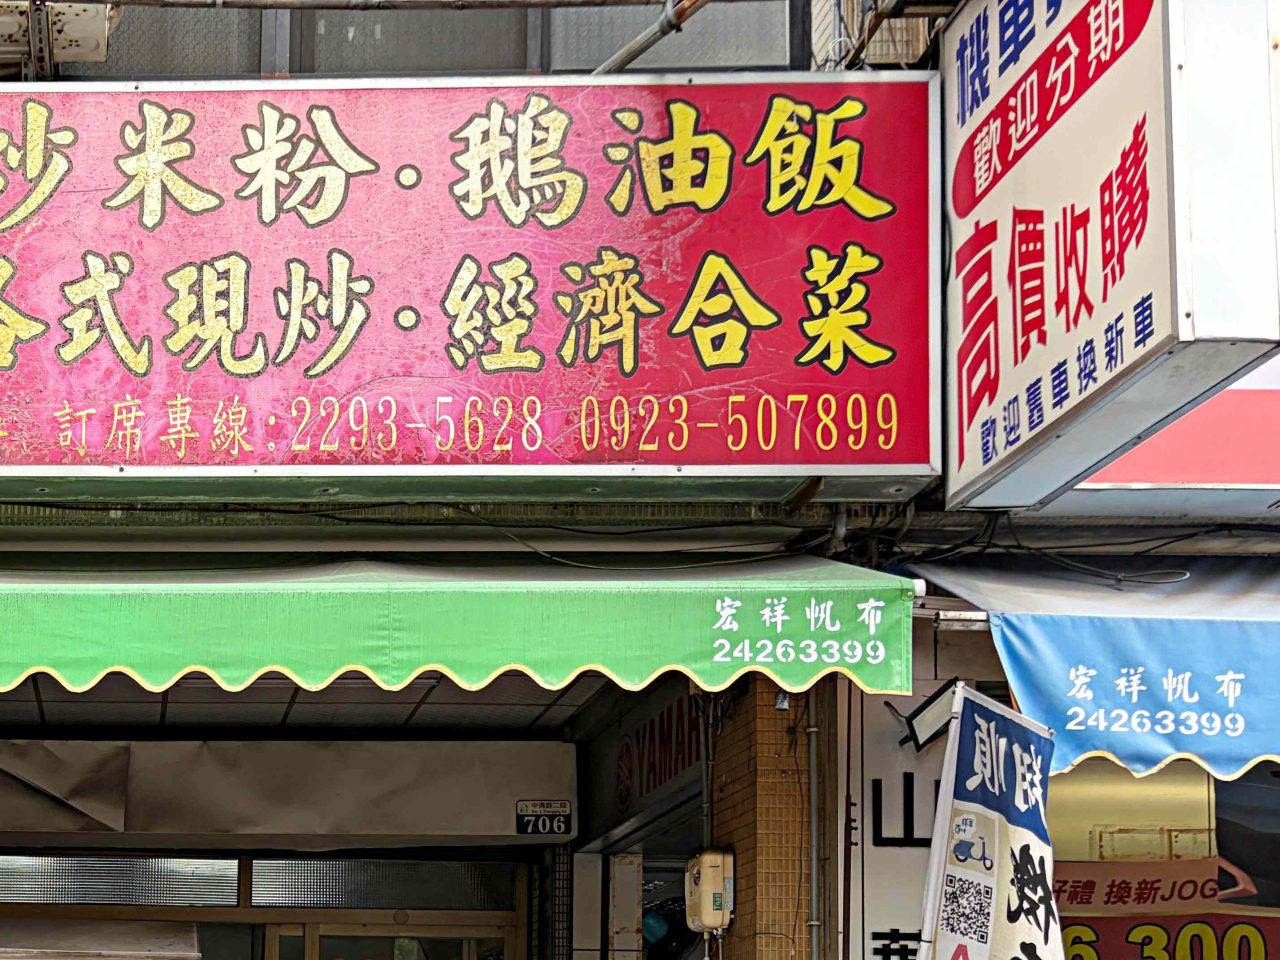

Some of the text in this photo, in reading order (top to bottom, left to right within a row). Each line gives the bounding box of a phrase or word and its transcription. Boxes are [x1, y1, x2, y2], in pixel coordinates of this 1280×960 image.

[956, 0, 1062, 127] 機車
[973, 0, 1124, 196] 歡迎分期
[955, 112, 1149, 473] 高價收購
[981, 292, 1154, 466] 歡迎舊車換新車
[579, 394, 898, 452] 0923-507899
[712, 596, 886, 635] 宏祥帆布
[712, 639, 886, 664] 24263399
[1066, 665, 1246, 707] 宏祥帆布
[1065, 706, 1246, 737] 24263399
[524, 816, 565, 833] 706
